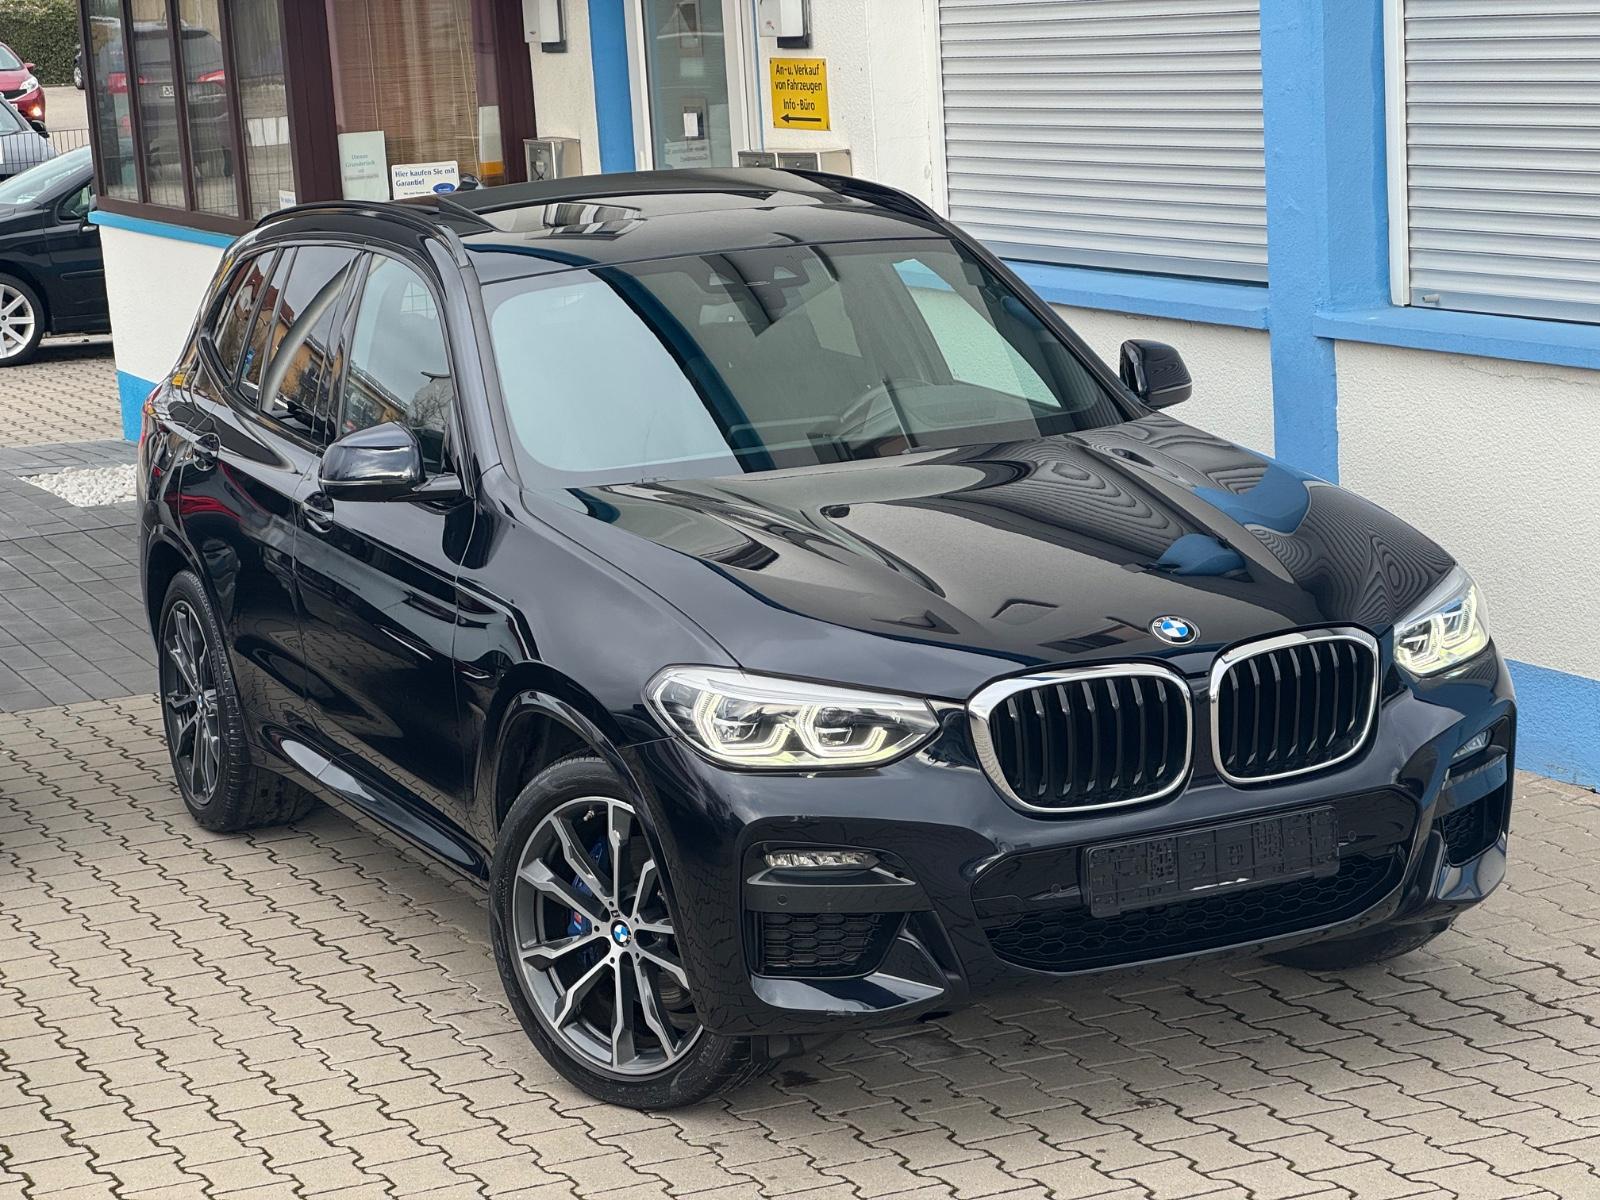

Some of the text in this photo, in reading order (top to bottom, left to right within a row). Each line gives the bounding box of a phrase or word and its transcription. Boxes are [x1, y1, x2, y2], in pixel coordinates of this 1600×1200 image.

[794, 64, 819, 75] Verkauf
[775, 79, 822, 93] von Fahrzeugen
[395, 170, 408, 178] Hier
[410, 169, 432, 177] kaufen
[433, 167, 443, 175] Sie
